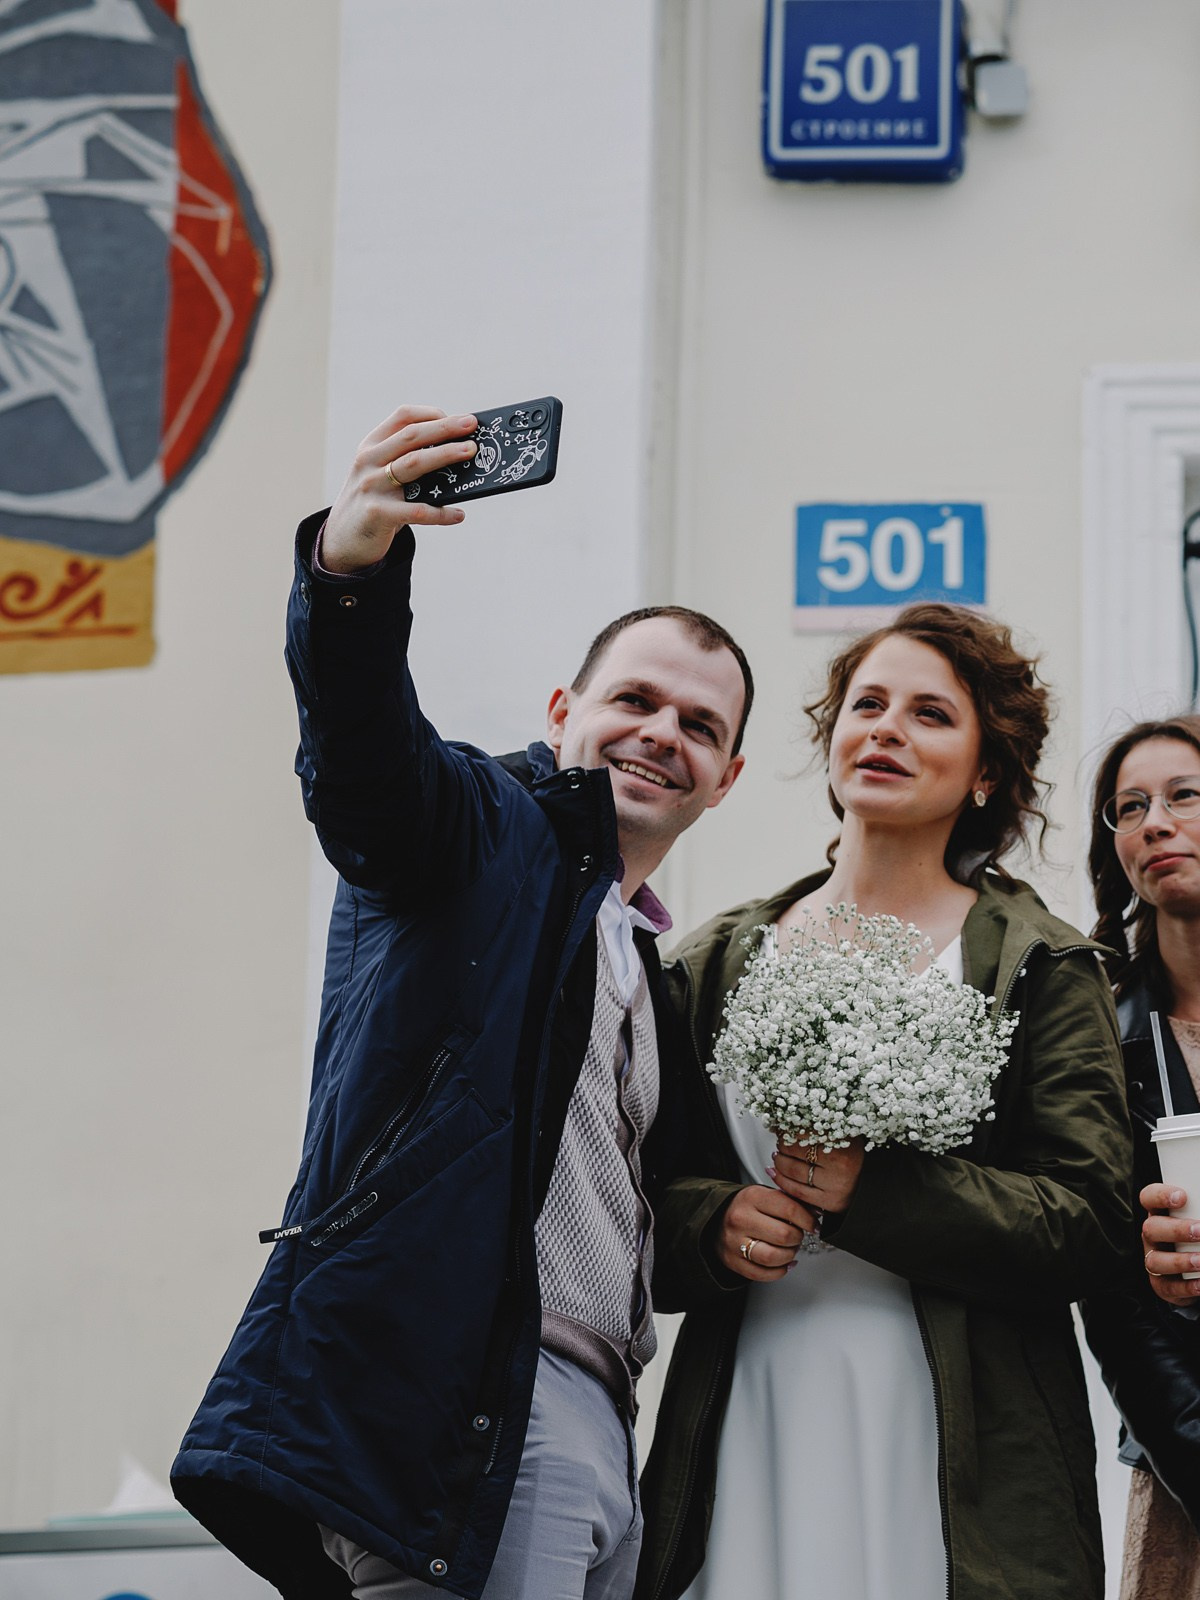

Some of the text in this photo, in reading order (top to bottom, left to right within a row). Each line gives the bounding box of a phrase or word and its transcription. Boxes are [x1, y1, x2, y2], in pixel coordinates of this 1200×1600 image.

[800, 43, 920, 104] 501
[790, 118, 928, 141] СТРОЕНИЕ
[816, 516, 965, 593] 501
